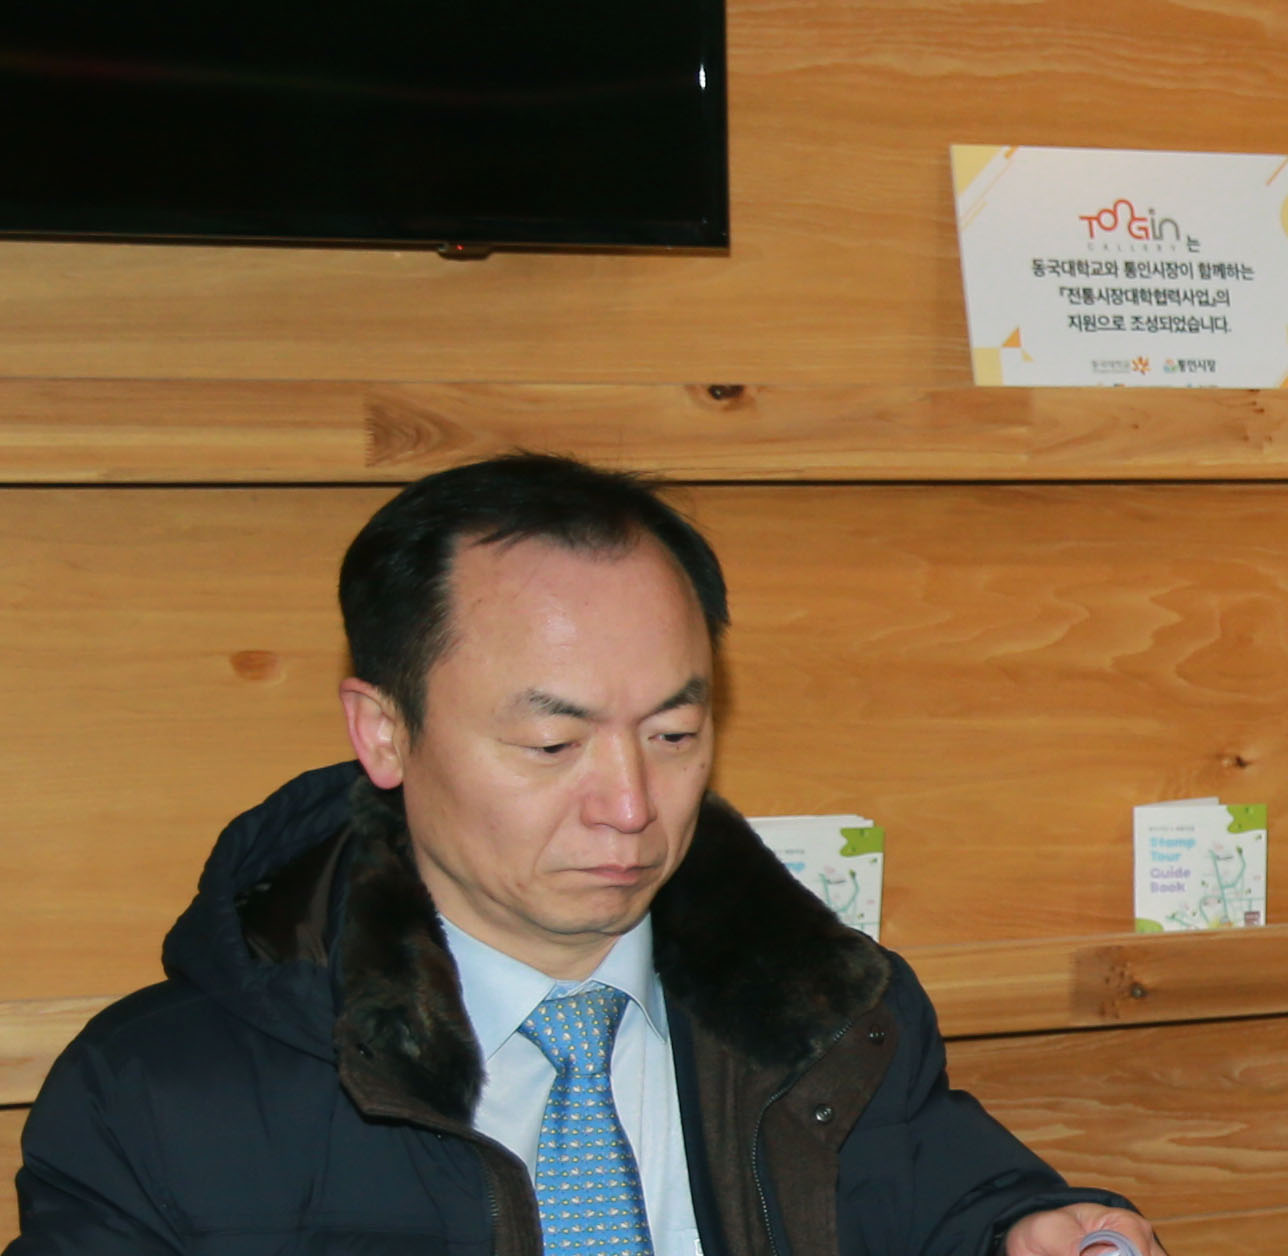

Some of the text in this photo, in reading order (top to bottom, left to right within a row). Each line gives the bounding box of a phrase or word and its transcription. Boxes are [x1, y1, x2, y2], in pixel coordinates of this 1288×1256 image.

[1186, 235, 1200, 253] 는
[1031, 258, 1254, 281] 동국대학교와 통인시장이 함께하는
[1068, 314, 1232, 334] 지원으로 조성되었습니다.
[1178, 359, 1216, 374] 통인시장
[1150, 867, 1191, 879] Guide
[1150, 881, 1186, 893] Book
